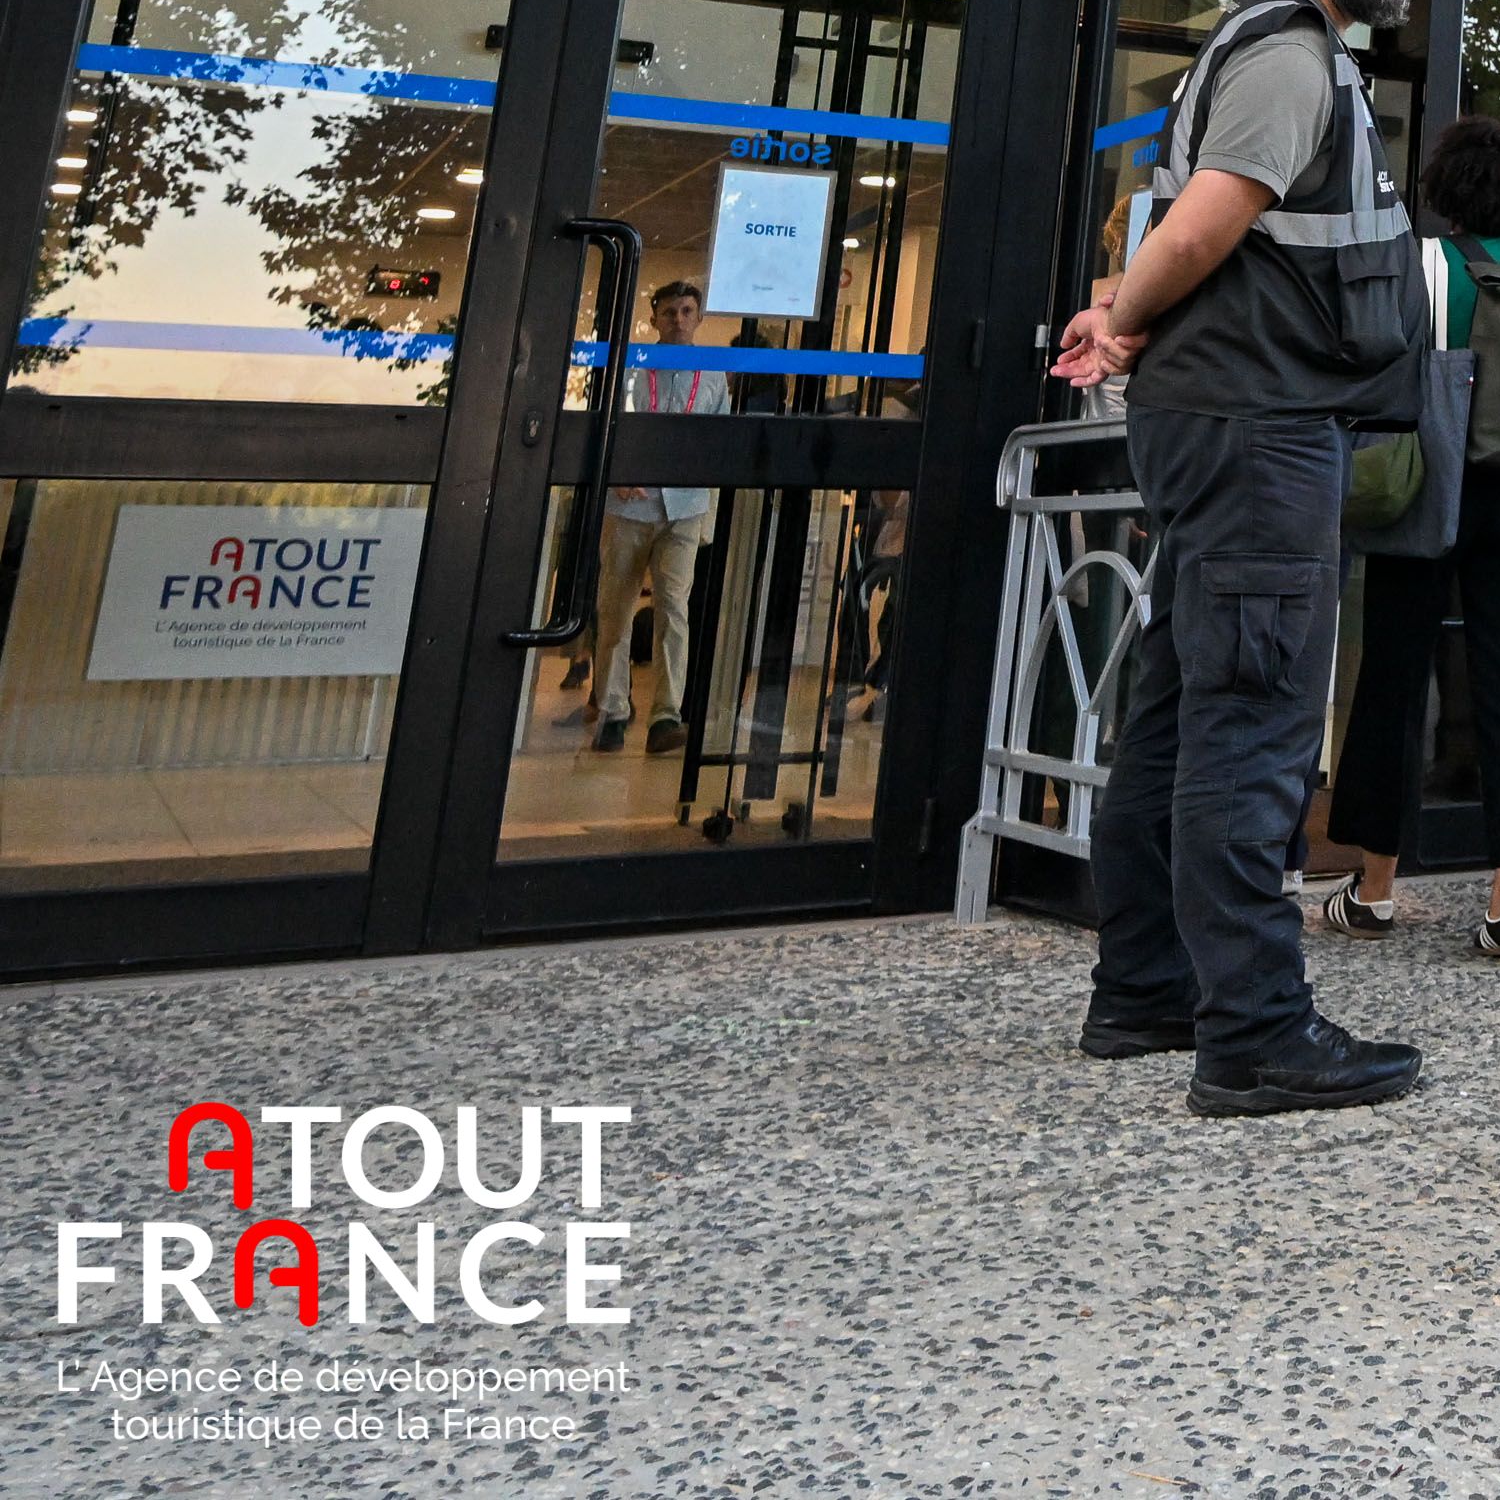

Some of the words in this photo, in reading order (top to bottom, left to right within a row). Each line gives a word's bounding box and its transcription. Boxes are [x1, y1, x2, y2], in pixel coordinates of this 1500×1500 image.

[745, 223, 797, 238] SORTIE
[210, 536, 381, 572] ATOUT
[159, 574, 376, 610] FRANCE
[229, 619, 250, 632] de
[252, 619, 367, 635] développement
[173, 634, 252, 651] touristique
[256, 634, 276, 647] de
[279, 634, 293, 647] la
[296, 635, 346, 647] France
